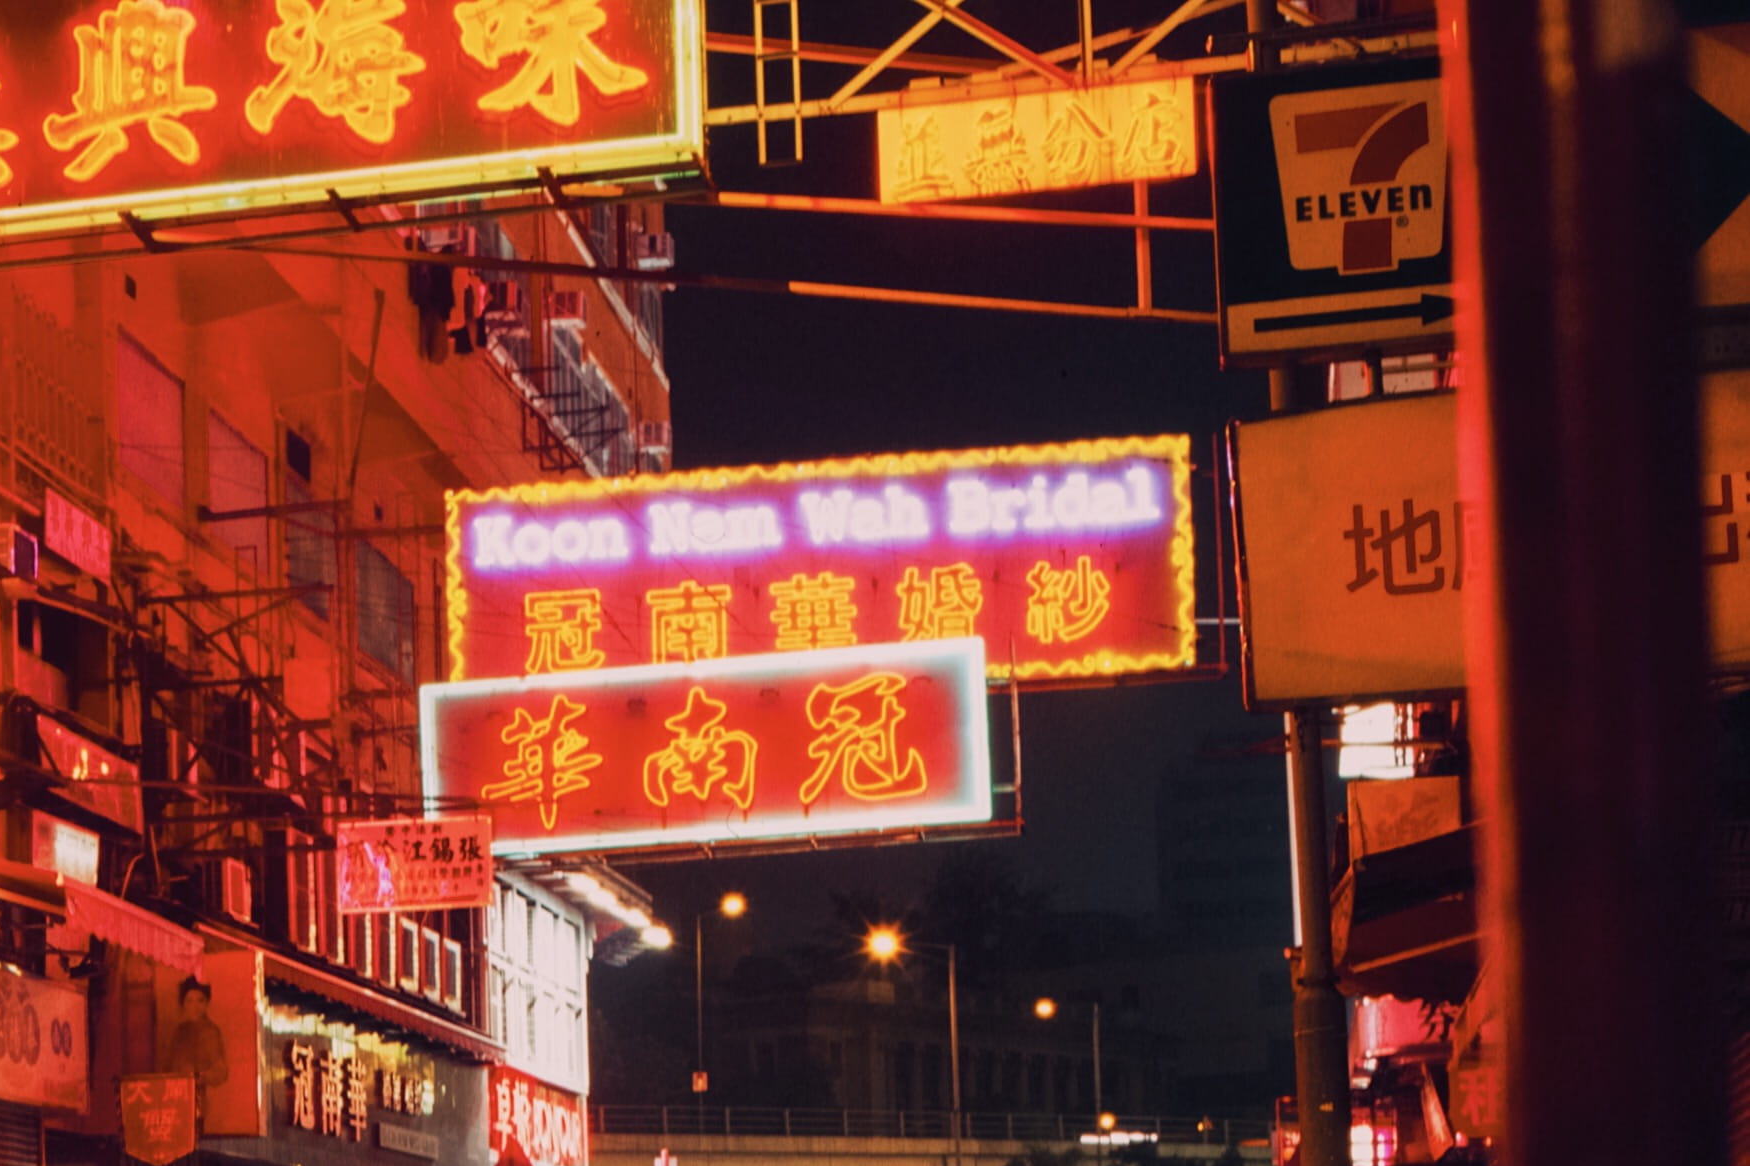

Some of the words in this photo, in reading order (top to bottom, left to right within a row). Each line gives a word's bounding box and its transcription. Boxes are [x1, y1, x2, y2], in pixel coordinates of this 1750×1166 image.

[1295, 101, 1429, 271] 7
[476, 515, 628, 568] Koon
[800, 485, 930, 544] Wah
[947, 467, 1161, 535] Bridal
[524, 556, 1110, 673] 冠南華婚紗
